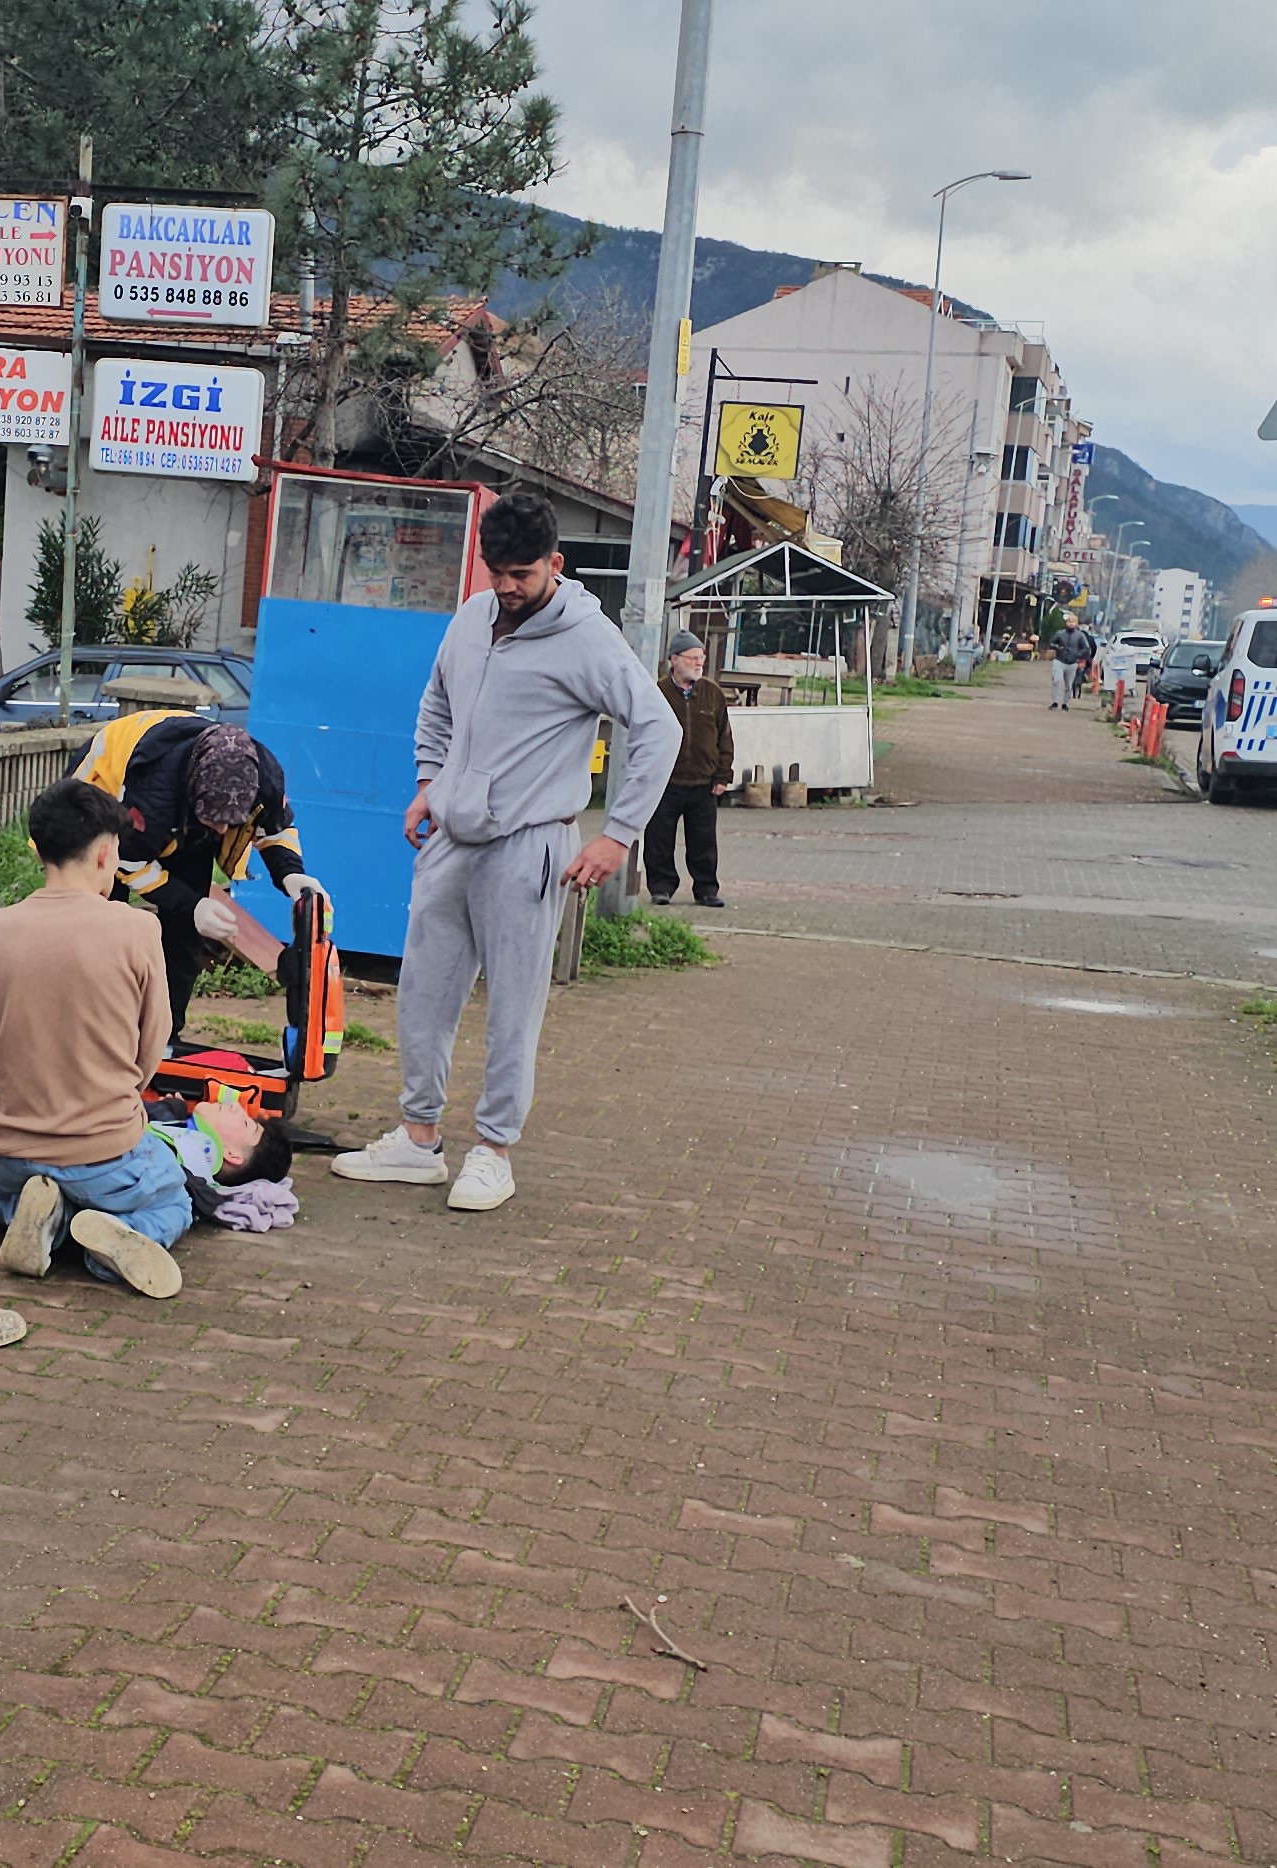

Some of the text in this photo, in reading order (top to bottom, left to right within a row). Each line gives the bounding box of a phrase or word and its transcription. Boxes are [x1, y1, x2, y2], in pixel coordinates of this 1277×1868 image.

[118, 214, 251, 246] BAKCAKLAR
[108, 246, 255, 285] PANSİYON
[13, 274, 30, 286] 93
[37, 275, 53, 287] 13
[13, 290, 31, 303] 36
[36, 291, 51, 303] 81
[114, 284, 249, 307] 0 535 848 88 86
[119, 369, 223, 413] İZGİ
[15, 415, 32, 425] 920
[35, 416, 46, 426] 87
[50, 417, 61, 426] 28
[15, 428, 31, 438] 603
[35, 429, 46, 438] 32
[49, 430, 59, 439] 87
[100, 409, 244, 452] AİLE PANSİYONU
[1063, 551, 1095, 560] OTEL
